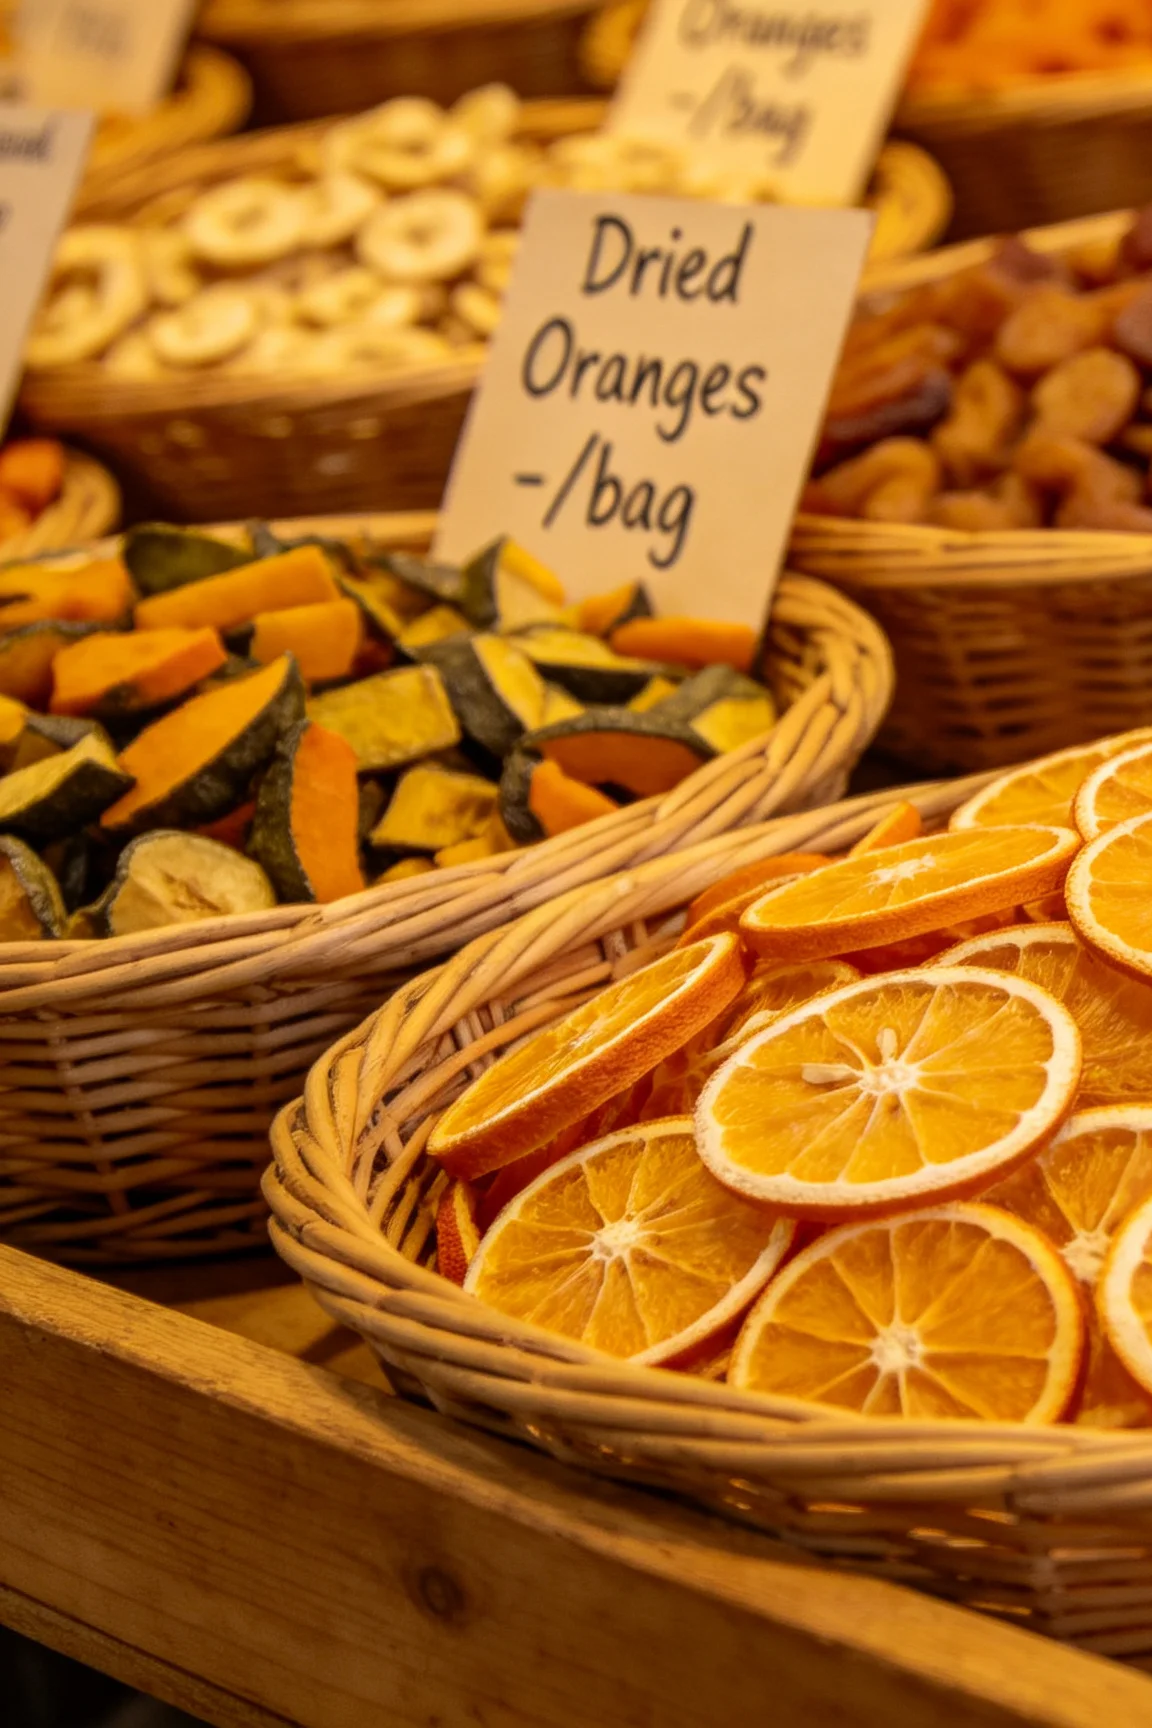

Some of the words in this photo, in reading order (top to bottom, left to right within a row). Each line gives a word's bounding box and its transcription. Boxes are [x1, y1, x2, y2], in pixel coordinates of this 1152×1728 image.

[583, 213, 753, 304] Dried
[522, 315, 767, 443] Oranges
[514, 433, 694, 569] -/bag
